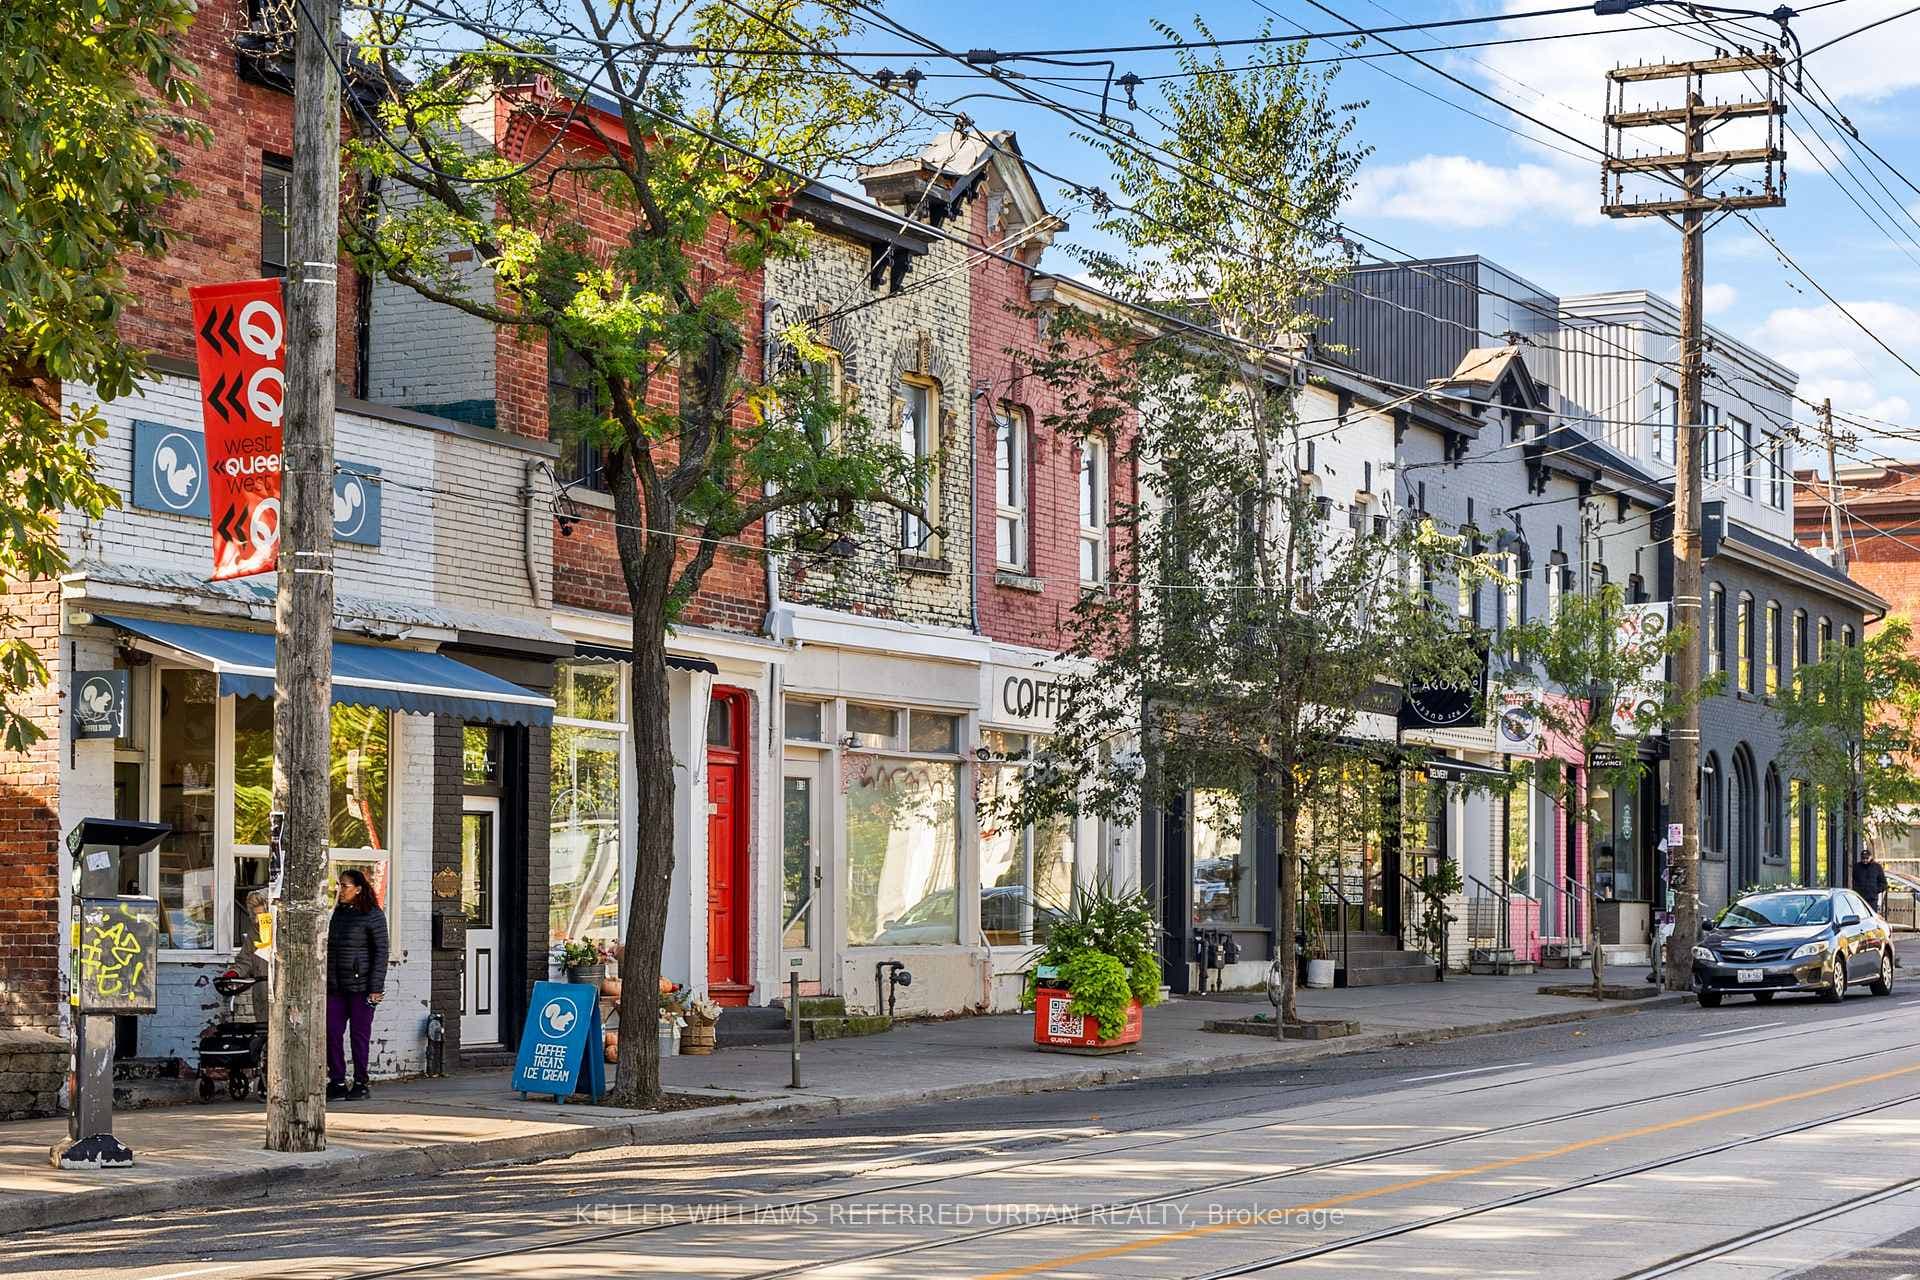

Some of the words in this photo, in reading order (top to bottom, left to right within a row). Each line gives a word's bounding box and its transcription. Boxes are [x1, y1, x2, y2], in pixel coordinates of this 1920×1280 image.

[238, 300, 283, 360] Q
[247, 367, 284, 427] Q
[224, 435, 273, 455] west
[225, 453, 282, 477] Quee
[226, 474, 273, 495] west
[535, 1043, 568, 1058] COFFEE
[534, 1055, 565, 1069] TREATS
[523, 1066, 540, 1080] ICE
[542, 1068, 570, 1082] CREAM
